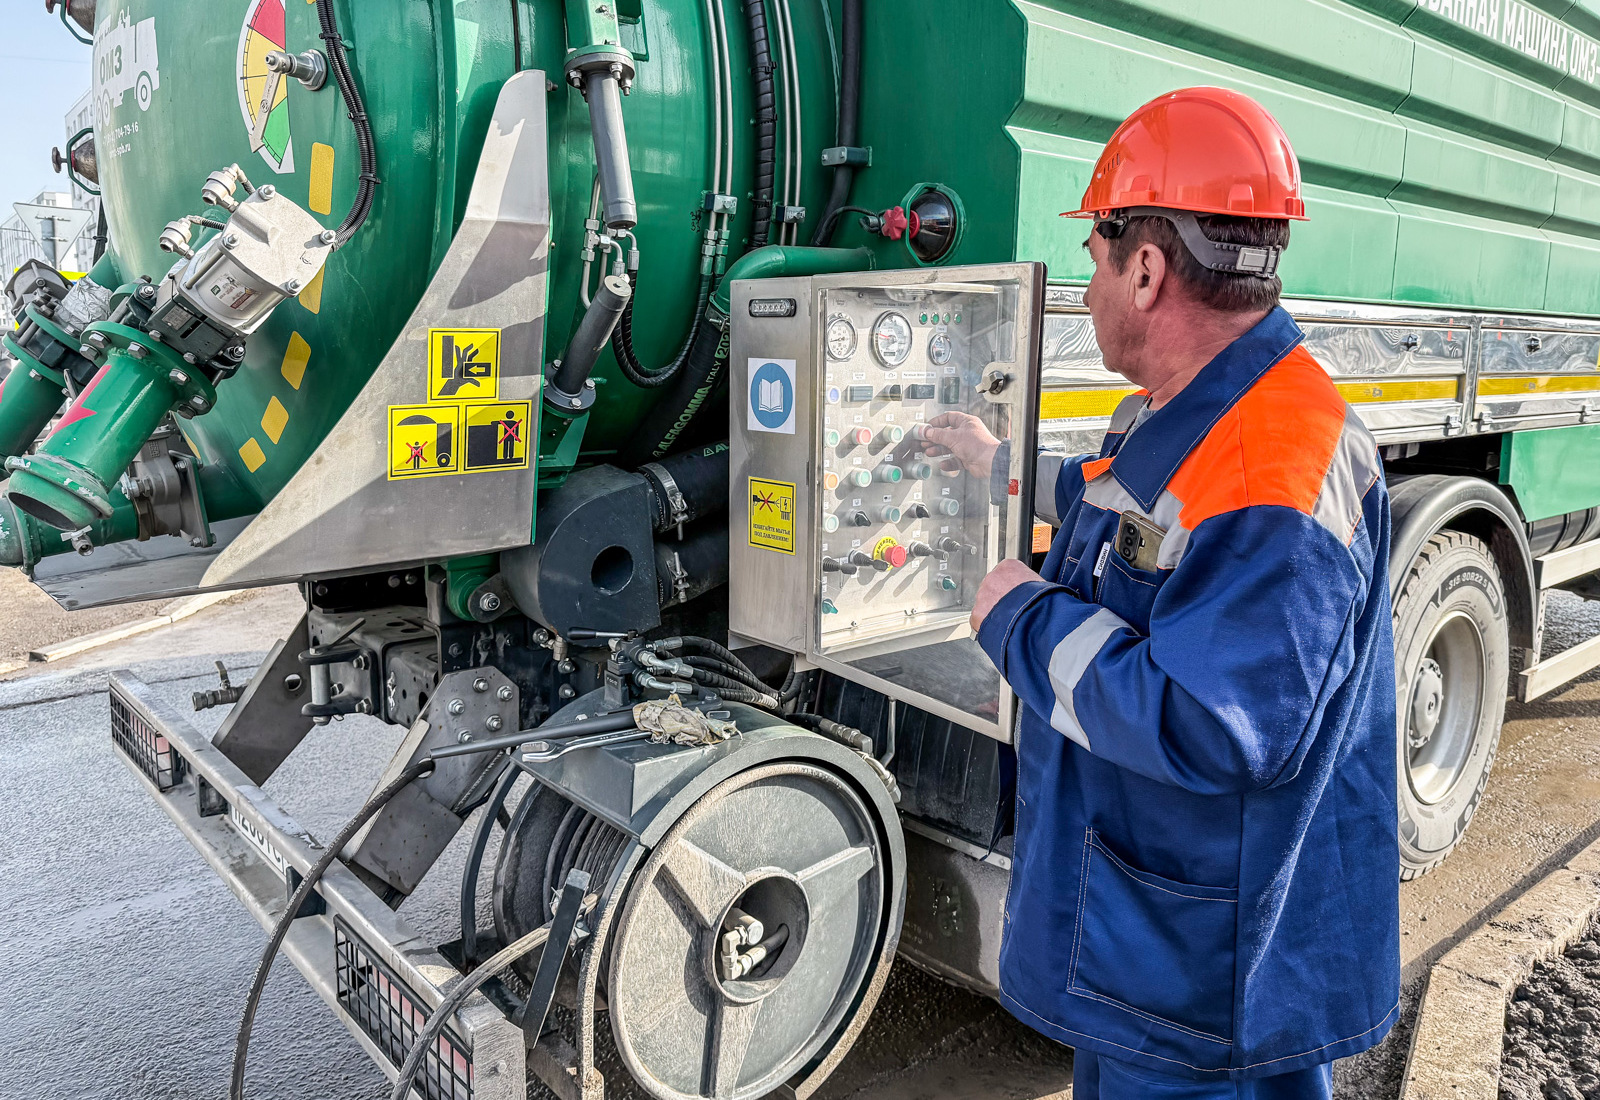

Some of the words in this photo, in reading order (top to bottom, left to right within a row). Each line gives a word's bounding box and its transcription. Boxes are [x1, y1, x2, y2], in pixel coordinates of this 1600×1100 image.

[1417, 0, 1499, 40] АННАЯ
[1502, 2, 1568, 71] МАШИНА
[100, 45, 123, 85] ОМЗ
[658, 385, 712, 450] ALFAGOMMA
[705, 361, 722, 383] ITALY
[876, 538, 897, 553] EMERGENC
